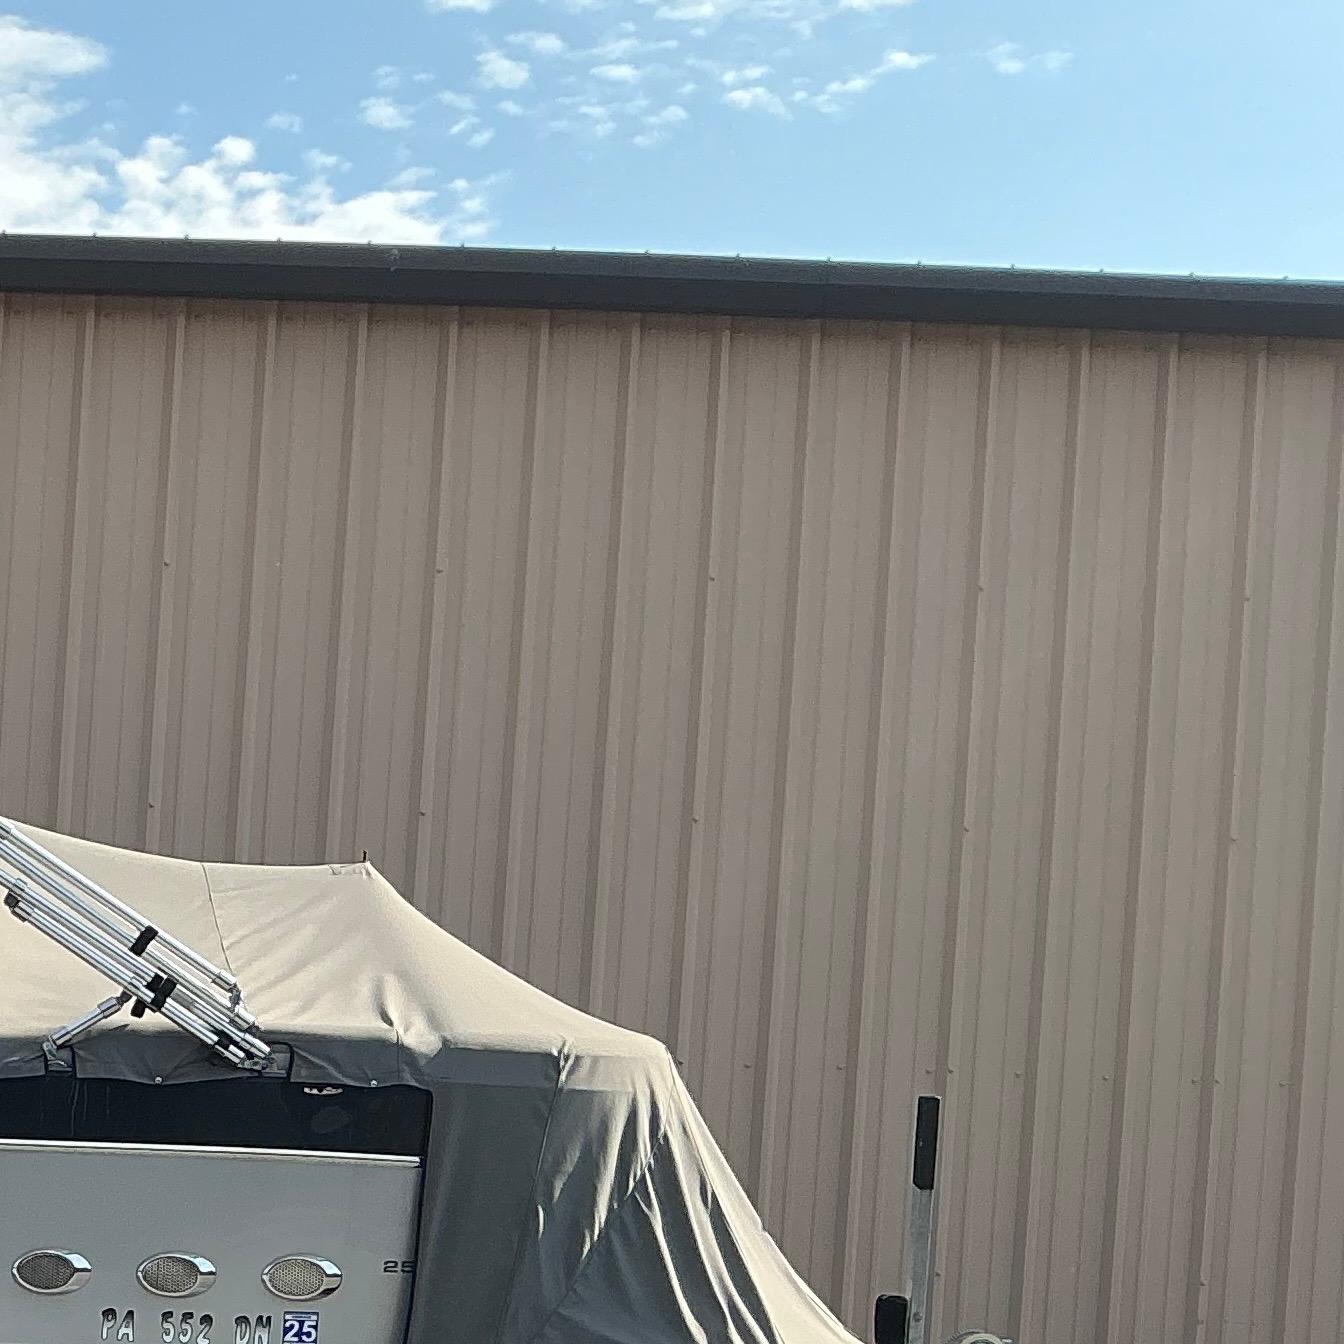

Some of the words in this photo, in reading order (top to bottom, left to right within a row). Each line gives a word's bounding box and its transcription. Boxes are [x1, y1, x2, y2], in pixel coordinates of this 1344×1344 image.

[383, 1260, 416, 1273] 25
[100, 1307, 135, 1343] PA
[284, 1320, 317, 1343] 25
